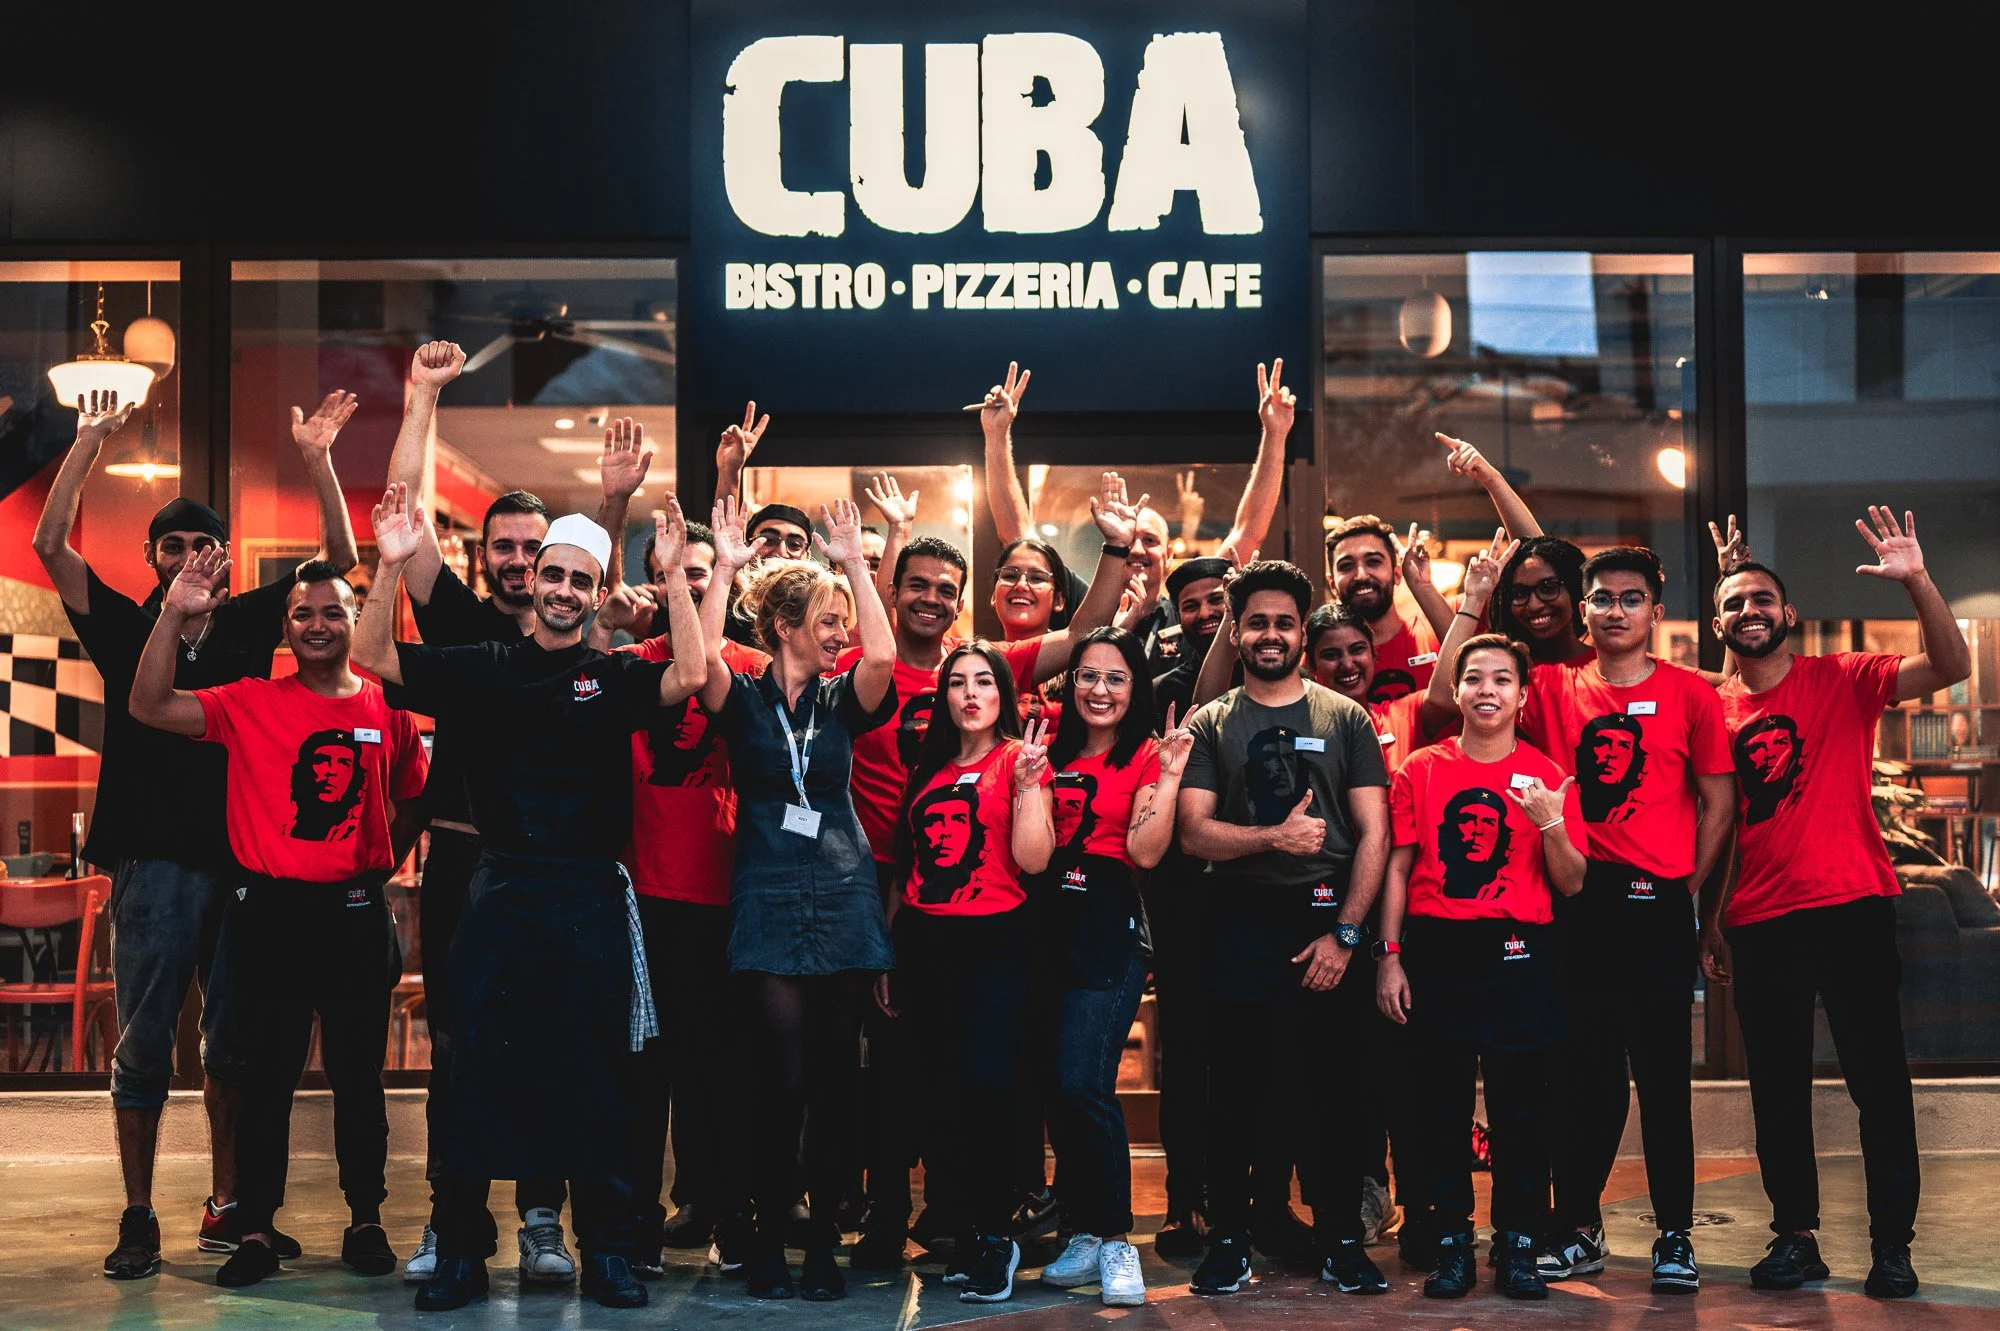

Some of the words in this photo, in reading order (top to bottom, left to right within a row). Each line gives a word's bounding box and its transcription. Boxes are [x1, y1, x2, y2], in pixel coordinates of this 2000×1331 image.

[723, 32, 1264, 237] CUBA
[725, 262, 886, 309] BISTRO
[912, 261, 1120, 309] PIZZERIA
[1148, 261, 1262, 308] CAFE
[573, 679, 600, 692] CUBA
[1066, 871, 1086, 883] CUBA
[1630, 881, 1653, 891] CUBA
[1313, 888, 1334, 897] CUBA
[1504, 940, 1526, 950] CUBA
